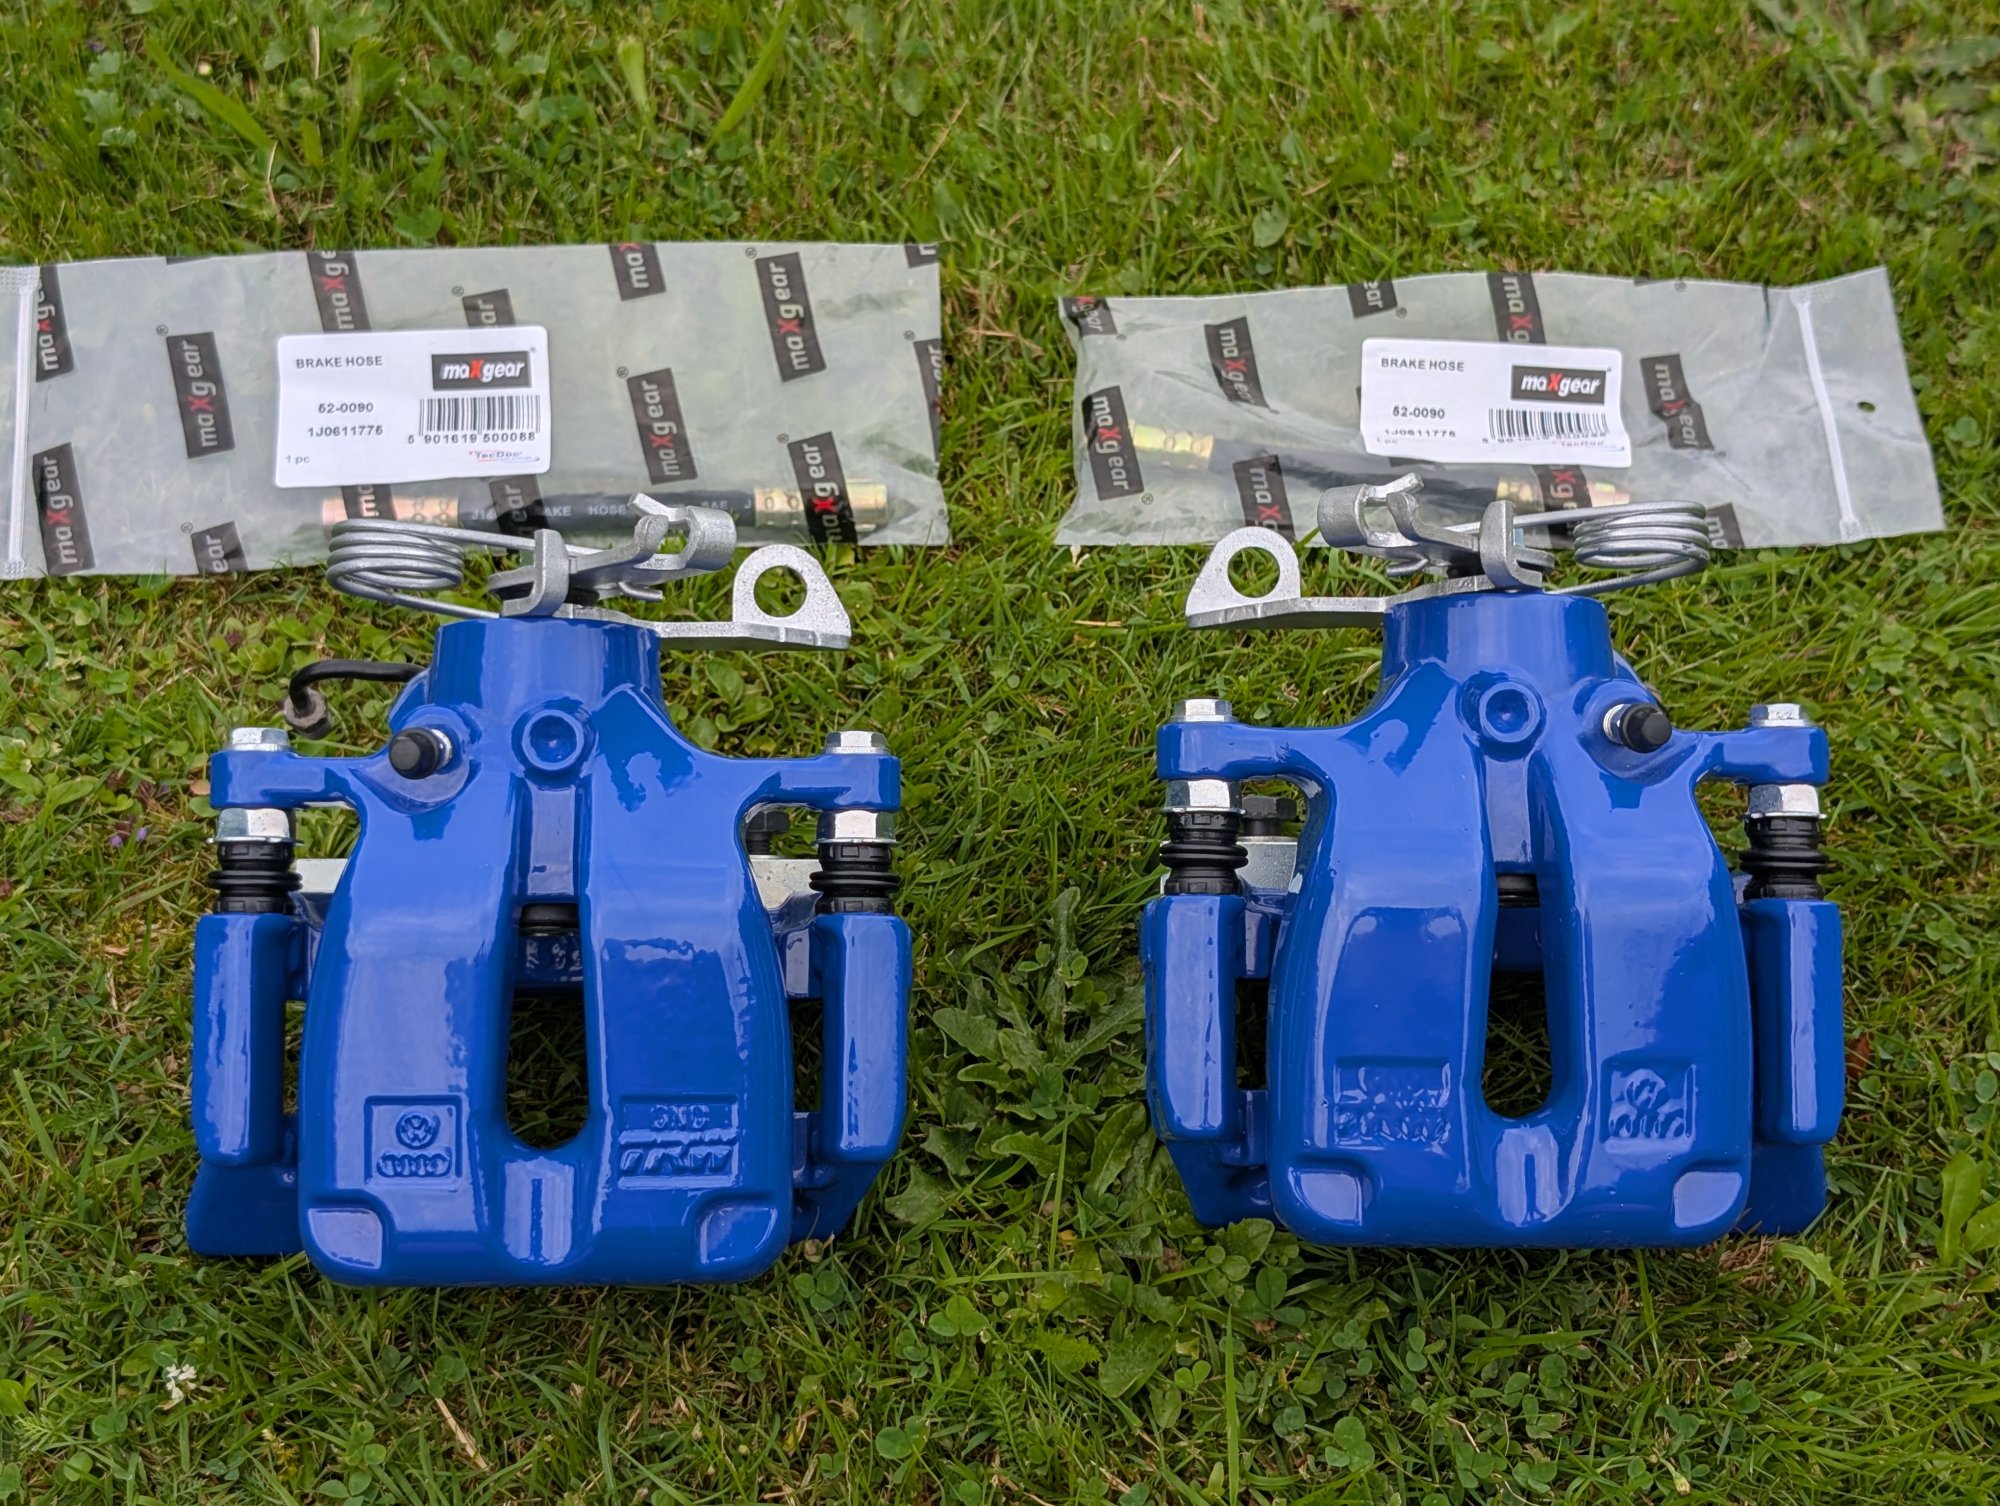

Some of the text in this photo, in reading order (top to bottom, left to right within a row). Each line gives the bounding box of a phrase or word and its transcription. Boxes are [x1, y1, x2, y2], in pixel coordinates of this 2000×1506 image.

[769, 262, 811, 370] maXgear
[295, 355, 384, 369] BRAKE HOSE
[1381, 357, 1465, 372] BRAKE HOSE
[440, 359, 526, 383] maXgear
[1520, 372, 1601, 397] maXgear
[182, 340, 218, 447] maXgear
[318, 402, 374, 414] 52-0090
[1392, 405, 1446, 419] 52-0090
[307, 425, 384, 437] 1J0611775
[641, 380, 681, 476] maXgear
[407, 431, 536, 444] 5 901619 500088
[1092, 396, 1129, 490] maXgear
[285, 454, 311, 465] 1 pc
[43, 456, 78, 564] maXgear
[543, 505, 573, 517] AKE
[588, 503, 627, 516] HOSE
